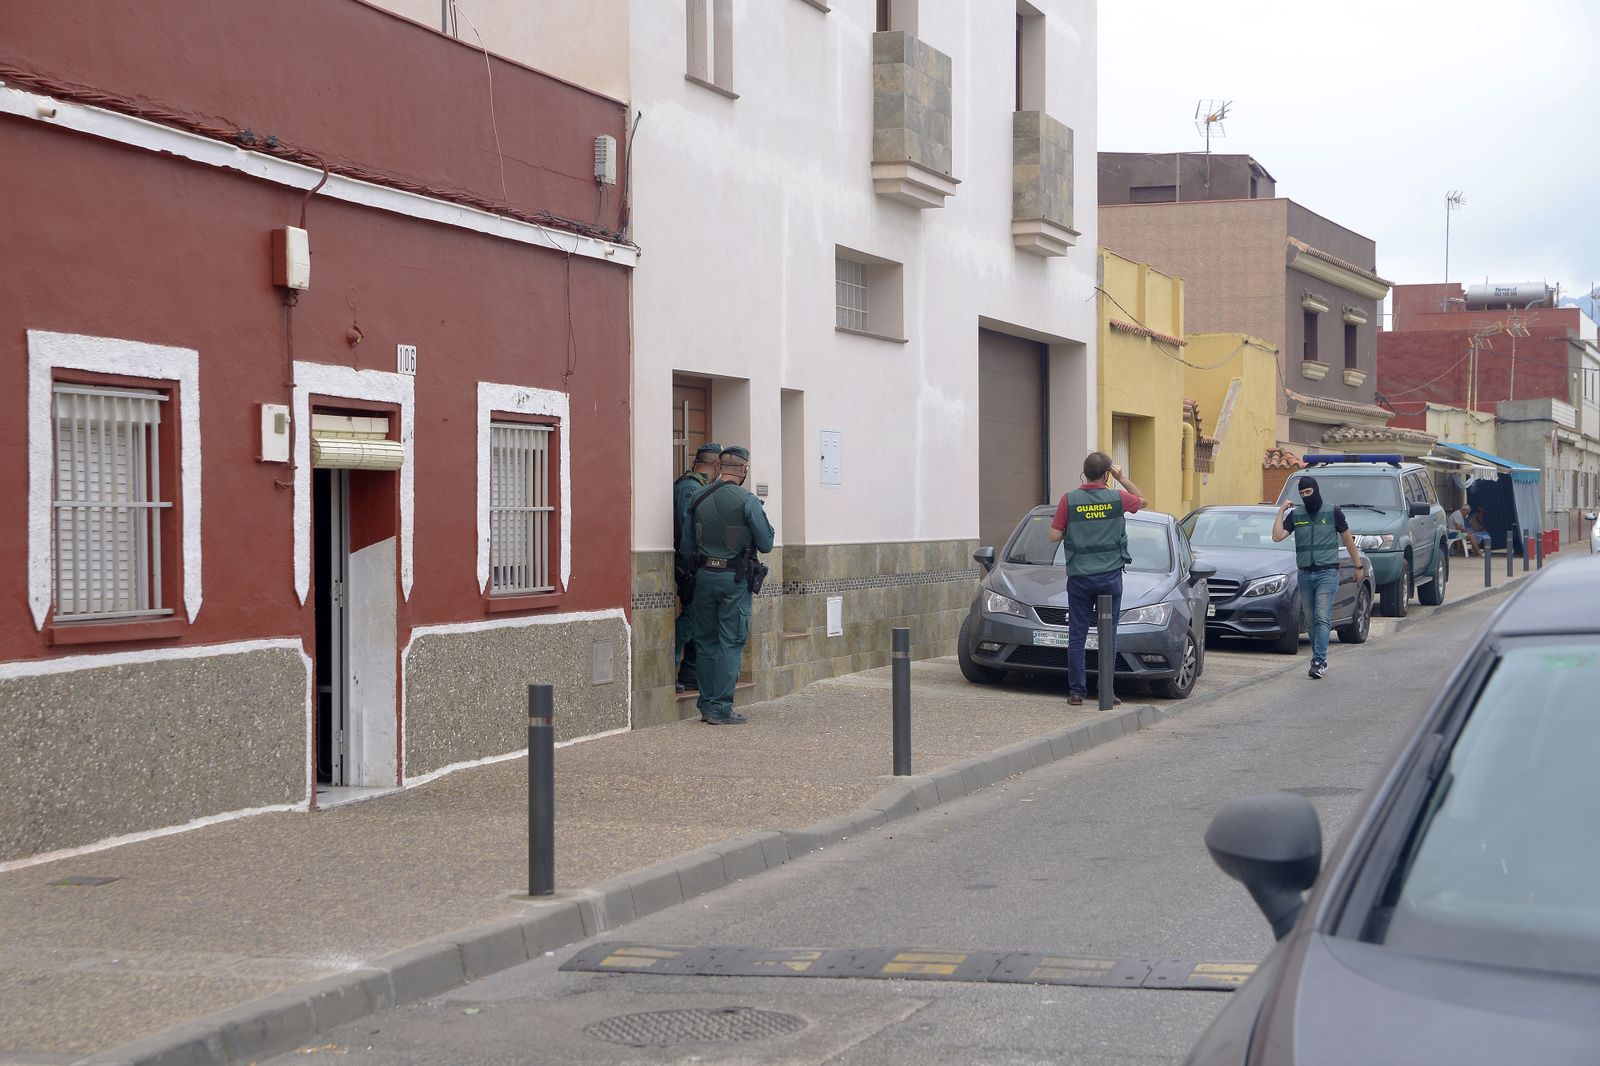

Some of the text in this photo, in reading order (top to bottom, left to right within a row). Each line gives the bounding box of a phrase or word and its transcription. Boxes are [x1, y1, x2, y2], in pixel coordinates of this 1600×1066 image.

[400, 347, 415, 372] 106
[1076, 503, 1113, 513] GUARDIA
[1085, 511, 1107, 519] CIVIL
